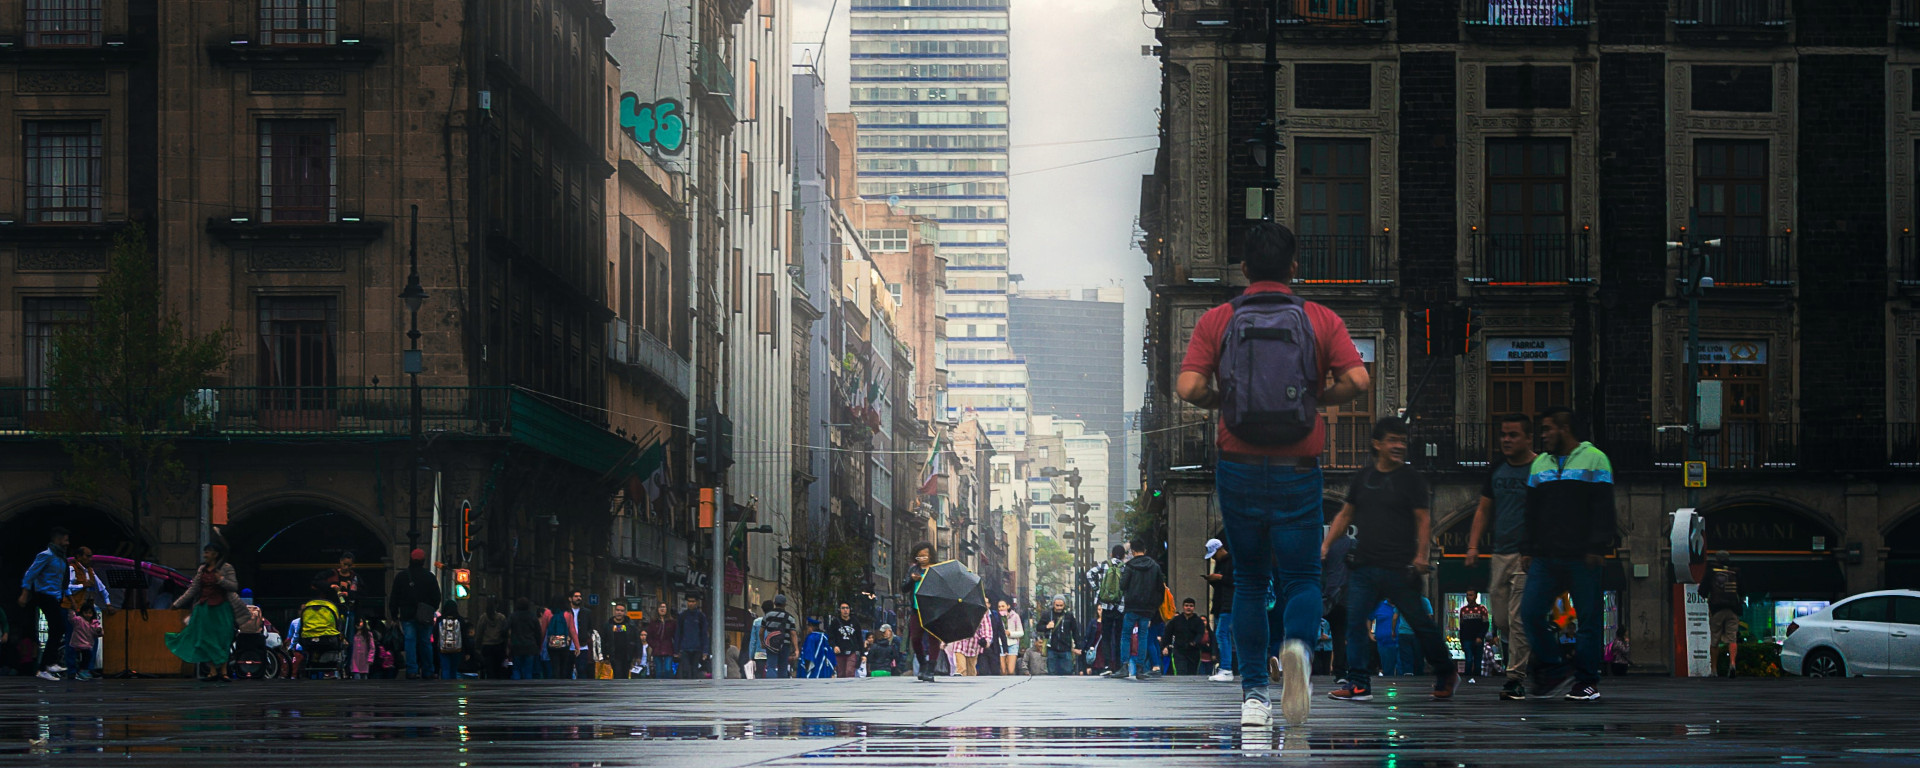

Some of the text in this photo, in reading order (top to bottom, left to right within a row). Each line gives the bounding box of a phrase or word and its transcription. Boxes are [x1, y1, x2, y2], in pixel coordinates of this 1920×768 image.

[620, 92, 687, 156] 46
[1511, 341, 1545, 349] FABRICAS
[1508, 351, 1548, 359] RELIGIOSOS
[1713, 522, 1795, 539] ARMANI
[686, 569, 707, 588] WC
